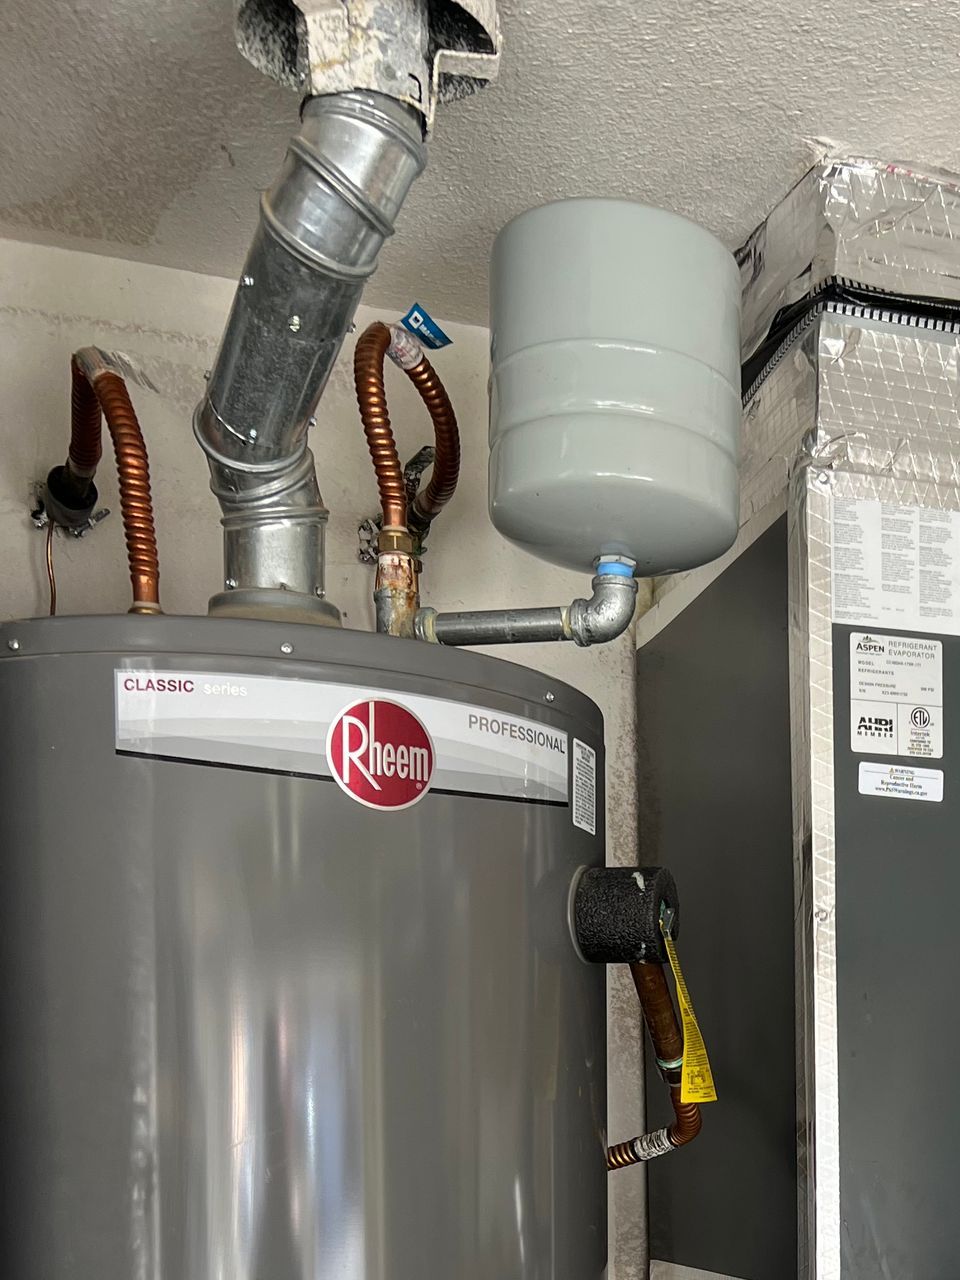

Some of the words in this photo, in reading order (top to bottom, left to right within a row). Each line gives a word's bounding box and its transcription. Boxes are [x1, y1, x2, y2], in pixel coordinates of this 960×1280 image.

[856, 642, 884, 652] ASPEN
[888, 640, 937, 651] REFRIGERANT
[888, 649, 934, 659] EVAPORATOR
[124, 678, 194, 692] CLASSIC
[203, 683, 248, 696] series
[858, 717, 893, 732] AHRI
[469, 714, 565, 754] PROFESSIONAL
[342, 701, 429, 791] Rheem
